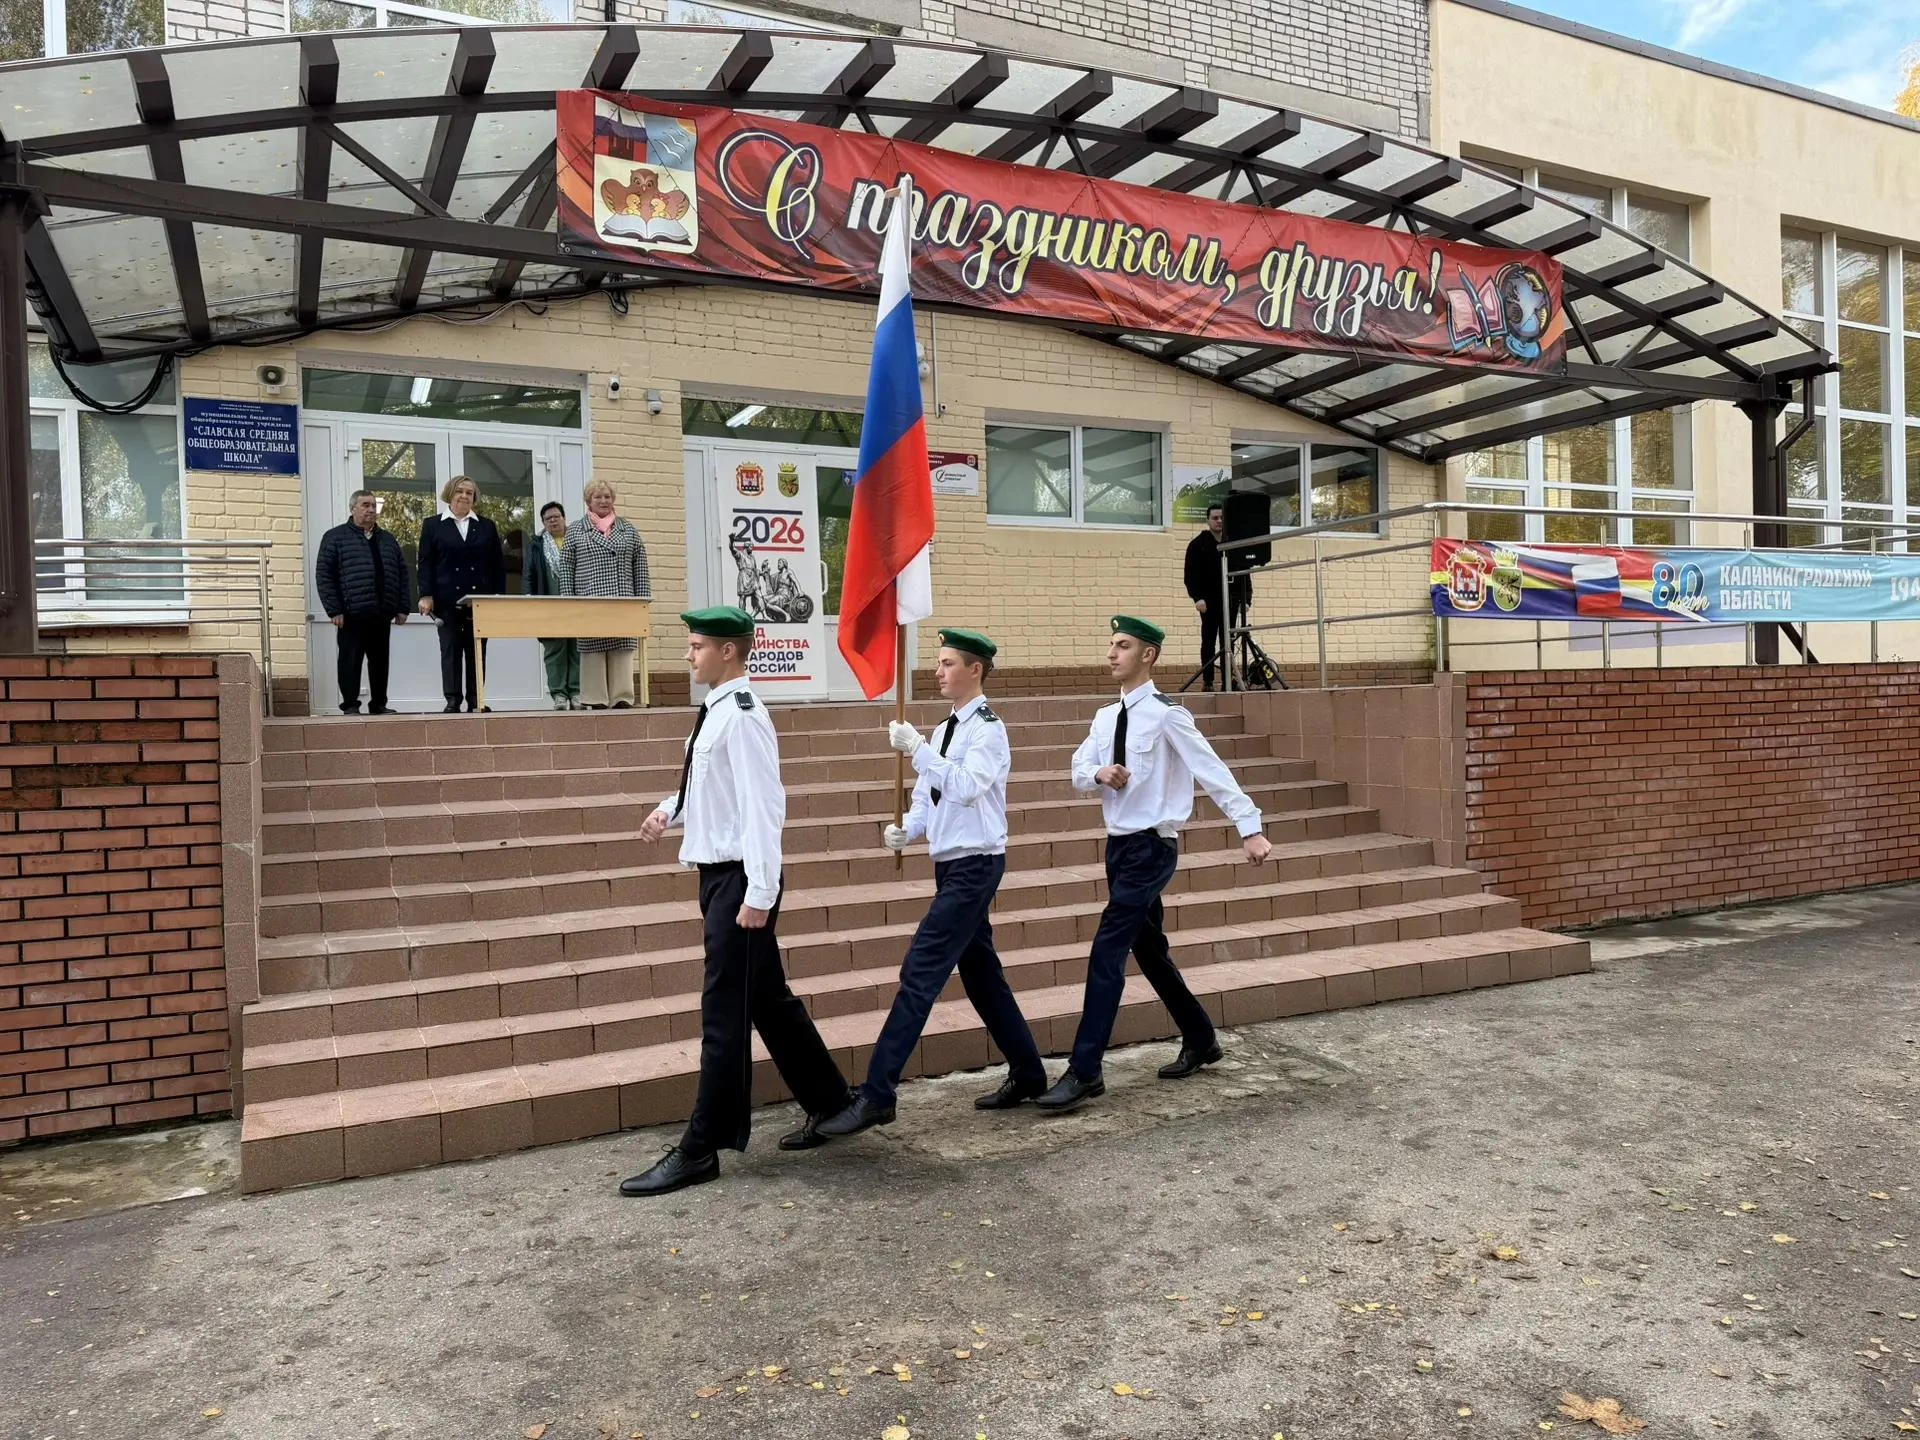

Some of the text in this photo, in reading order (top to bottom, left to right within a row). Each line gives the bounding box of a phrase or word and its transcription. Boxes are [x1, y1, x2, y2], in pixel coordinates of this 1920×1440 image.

[718, 131, 820, 260] С
[1259, 244, 1441, 337] друзья!
[193, 425, 290, 441] "СЛАВСКАЯ СРЕДНЯЯ
[187, 437, 296, 453] ОБЩЕОБРАЗОВАТЕЛЬНАЯ
[223, 452, 263, 463] ШКОЛА"
[732, 515, 805, 544] 2026
[1719, 563, 1872, 588] КАЛИНИНГРАДСКОЙ
[1652, 561, 1705, 609] 80
[1720, 589, 1792, 610] ОБЛАСТИ
[751, 639, 810, 650] ДИНСТВА
[747, 651, 804, 662] АРОДОВ
